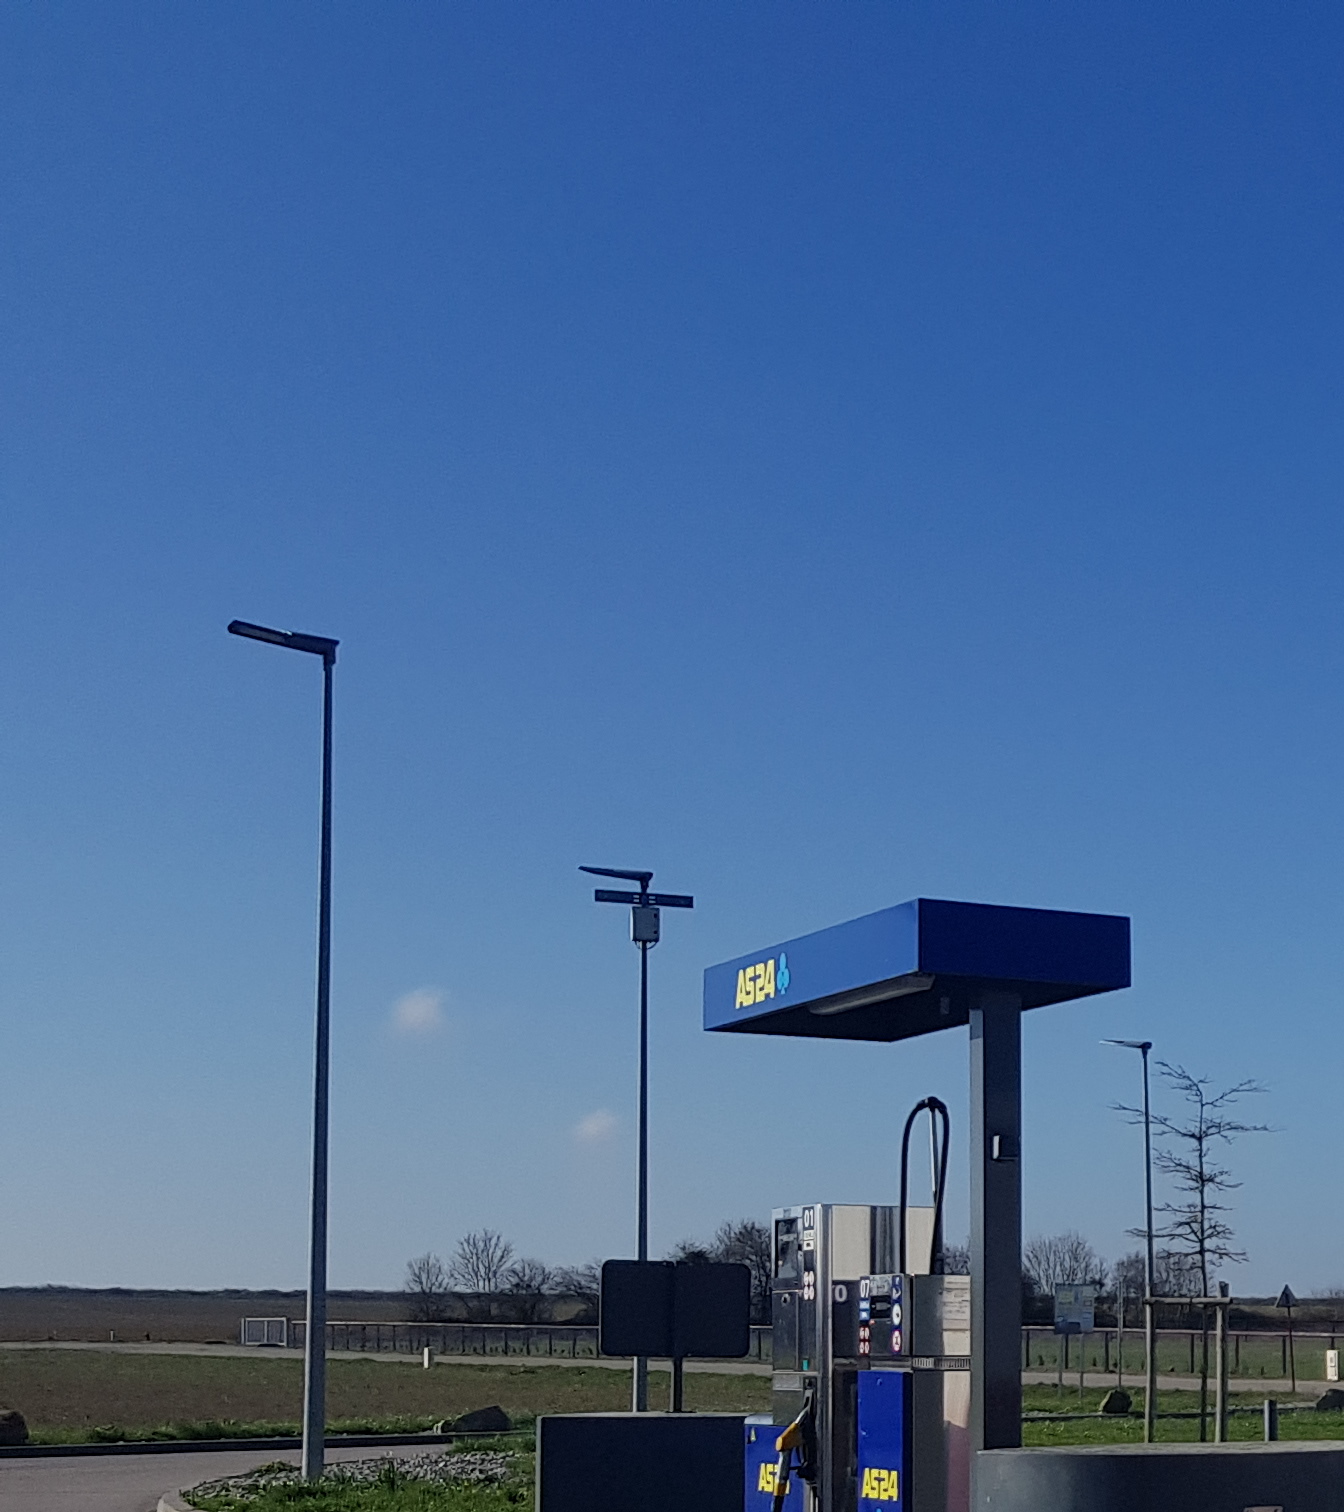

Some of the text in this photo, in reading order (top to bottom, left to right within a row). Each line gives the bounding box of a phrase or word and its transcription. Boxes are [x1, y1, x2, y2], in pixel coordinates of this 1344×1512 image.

[735, 958, 775, 1010] AS24
[804, 1208, 814, 1228] 01
[860, 1279, 870, 1299] 07
[861, 1467, 899, 1501] AS24
